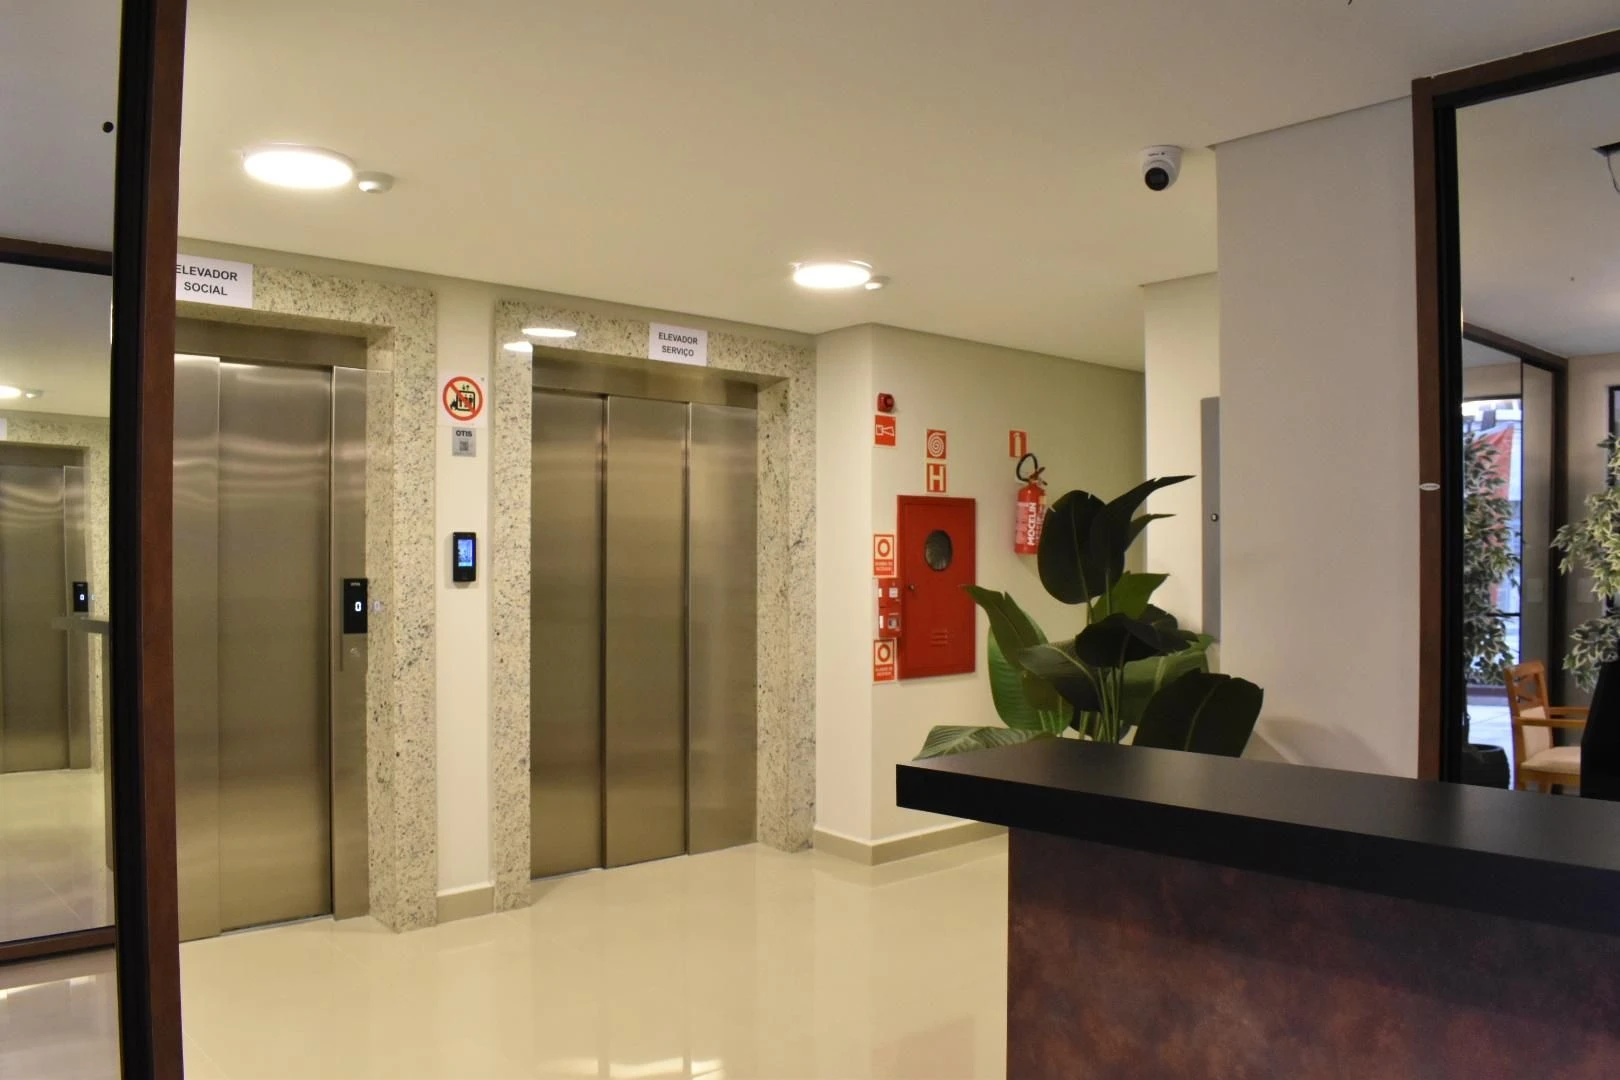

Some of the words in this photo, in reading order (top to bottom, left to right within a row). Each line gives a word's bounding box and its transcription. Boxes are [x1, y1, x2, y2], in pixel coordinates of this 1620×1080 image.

[176, 264, 238, 282] ELEVADOR
[184, 281, 228, 296] SOCIAL
[658, 332, 698, 344] ELEVADOR
[662, 345, 694, 357] SERVIÇO
[929, 465, 944, 491] H
[354, 601, 362, 612] 0
